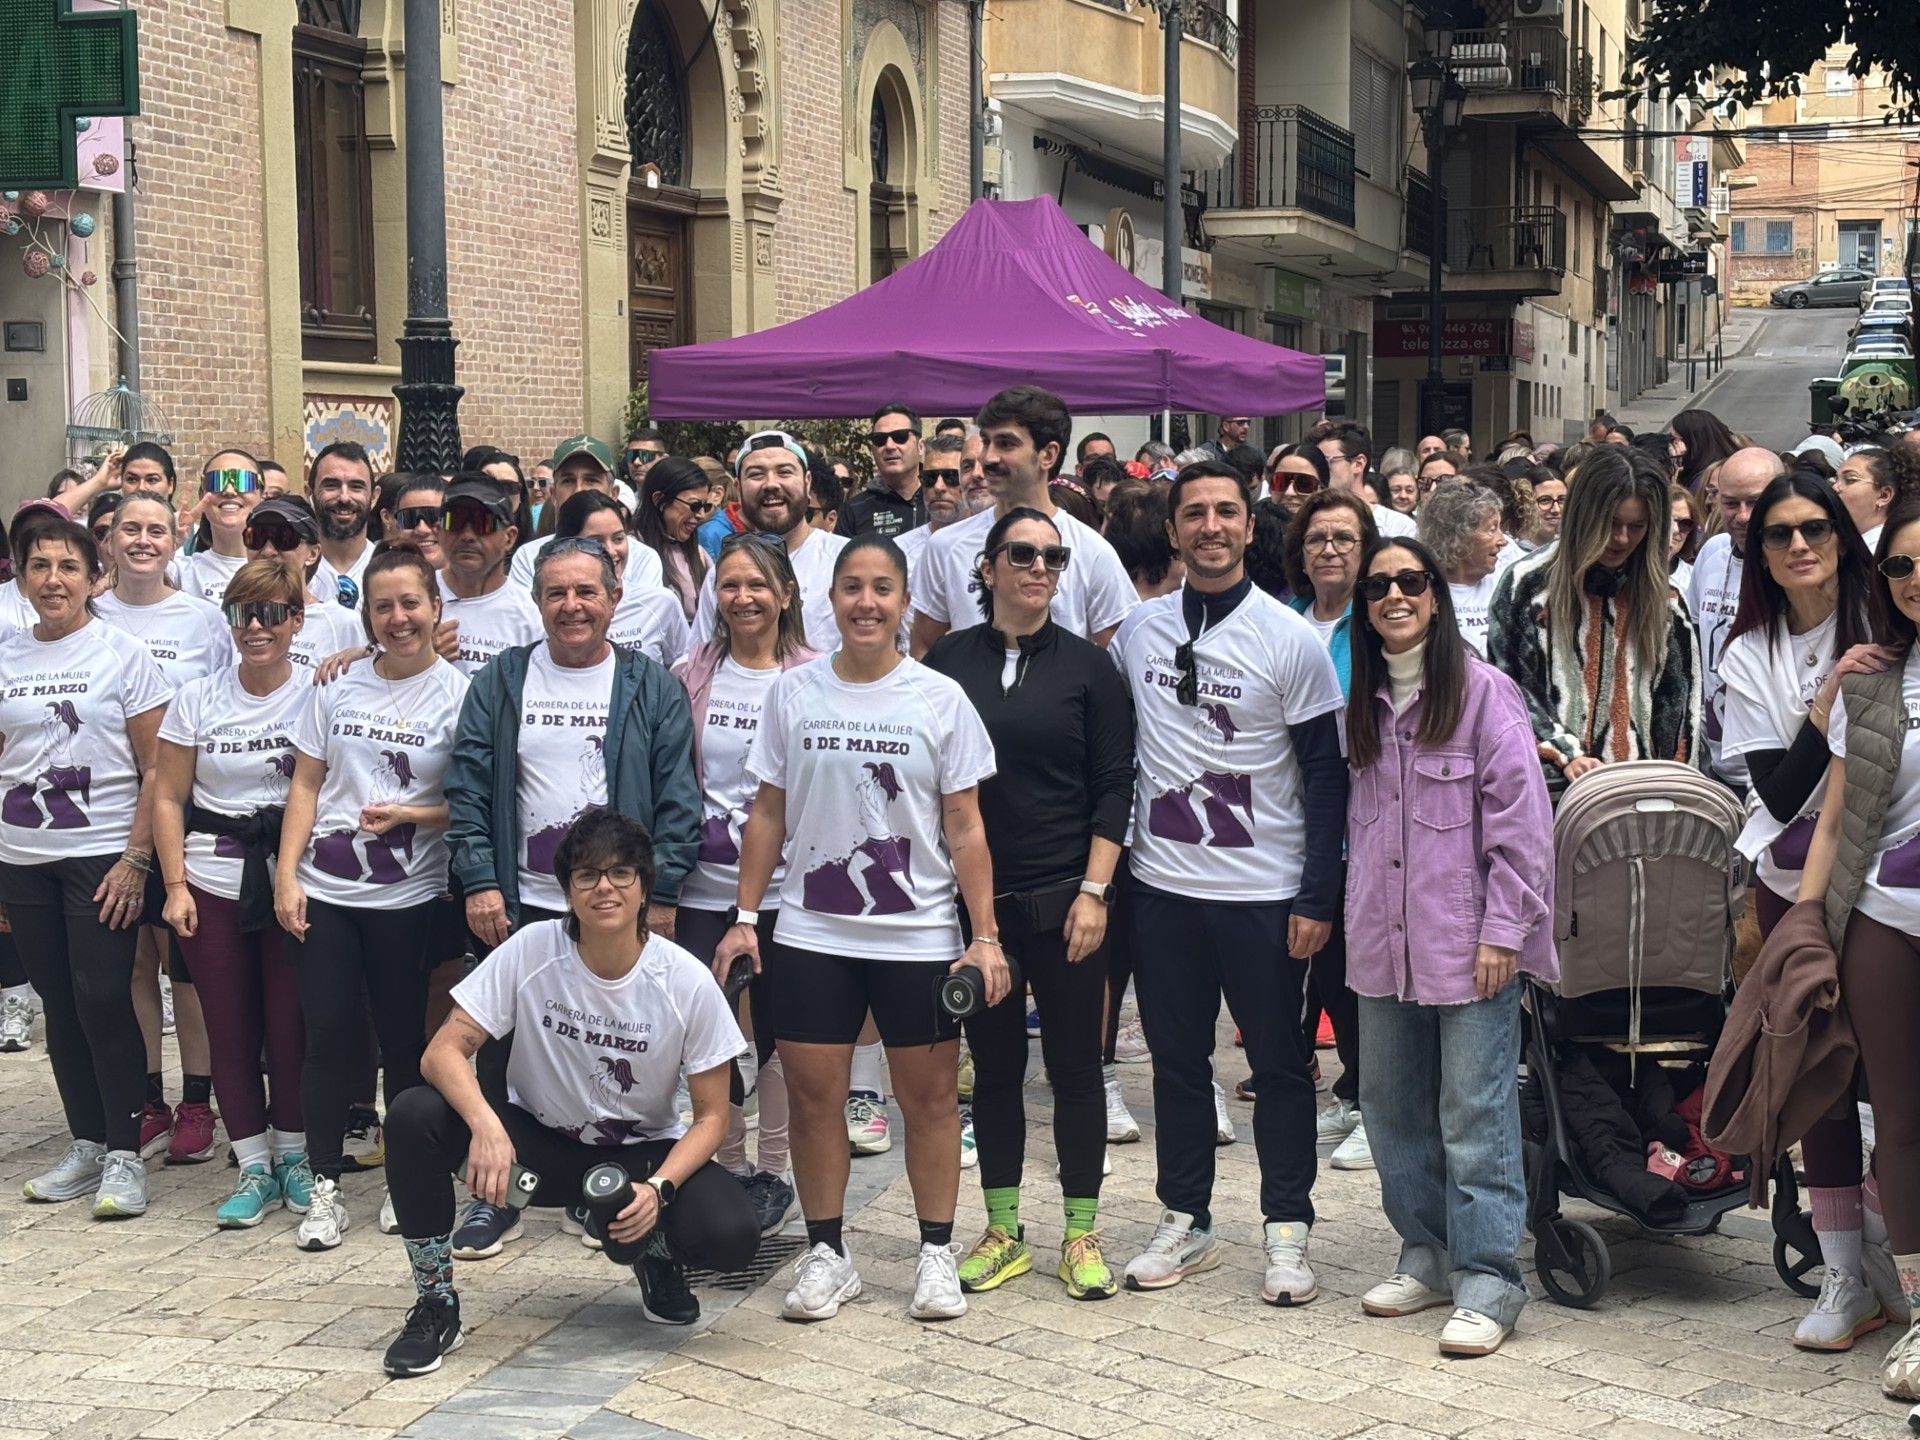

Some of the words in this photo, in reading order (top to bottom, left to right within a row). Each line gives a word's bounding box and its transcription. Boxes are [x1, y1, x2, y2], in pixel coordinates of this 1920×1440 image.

[1444, 323, 1467, 334] 446
[1471, 322, 1493, 333] 762
[1401, 336, 1490, 351] teleizza.es
[616, 627, 642, 638] MUJER
[150, 639, 180, 647] MUJER
[460, 635, 471, 644] DE
[473, 636, 484, 646] LA
[151, 649, 177, 660] RZO
[1145, 654, 1175, 669] CARRE
[1201, 665, 1212, 676] LA
[1213, 667, 1244, 680] MUJER
[36, 673, 47, 682] DE
[49, 672, 60, 681] LA
[61, 670, 91, 680] MUJER
[8, 686, 28, 698] DE
[32, 683, 88, 697] MARZO
[1144, 670, 1153, 684] 8
[1158, 673, 1180, 689] DE
[1197, 681, 1242, 699] ARZO
[526, 700, 569, 710] CARRERA
[571, 701, 584, 710] DE
[586, 702, 598, 710] LA
[738, 702, 749, 712] DE
[336, 708, 371, 721] CARRERA
[373, 714, 387, 725] DE
[388, 717, 398, 727] LA
[525, 713, 536, 725] 8
[541, 714, 564, 726] DE
[570, 715, 608, 727] MAR
[708, 713, 729, 727] DE
[205, 727, 247, 737] CARRERA
[803, 719, 846, 730] CARRERA
[847, 721, 861, 731] DE
[864, 722, 876, 733] LA
[878, 724, 913, 736] MUJER
[333, 724, 340, 736] 8
[343, 723, 363, 737] DE
[367, 727, 425, 747] MARZO
[206, 742, 216, 754] 8
[220, 742, 243, 754] DE
[803, 737, 812, 751] 8
[817, 736, 841, 750] DE
[846, 738, 910, 756] MARZO
[545, 999, 587, 1021] CARRERA
[588, 1014, 603, 1026] DE
[604, 1017, 617, 1029] LA
[618, 1021, 652, 1034] MUJER
[542, 1014, 552, 1029] 8
[556, 1021, 580, 1041] DE
[584, 1030, 649, 1053] MARZO
